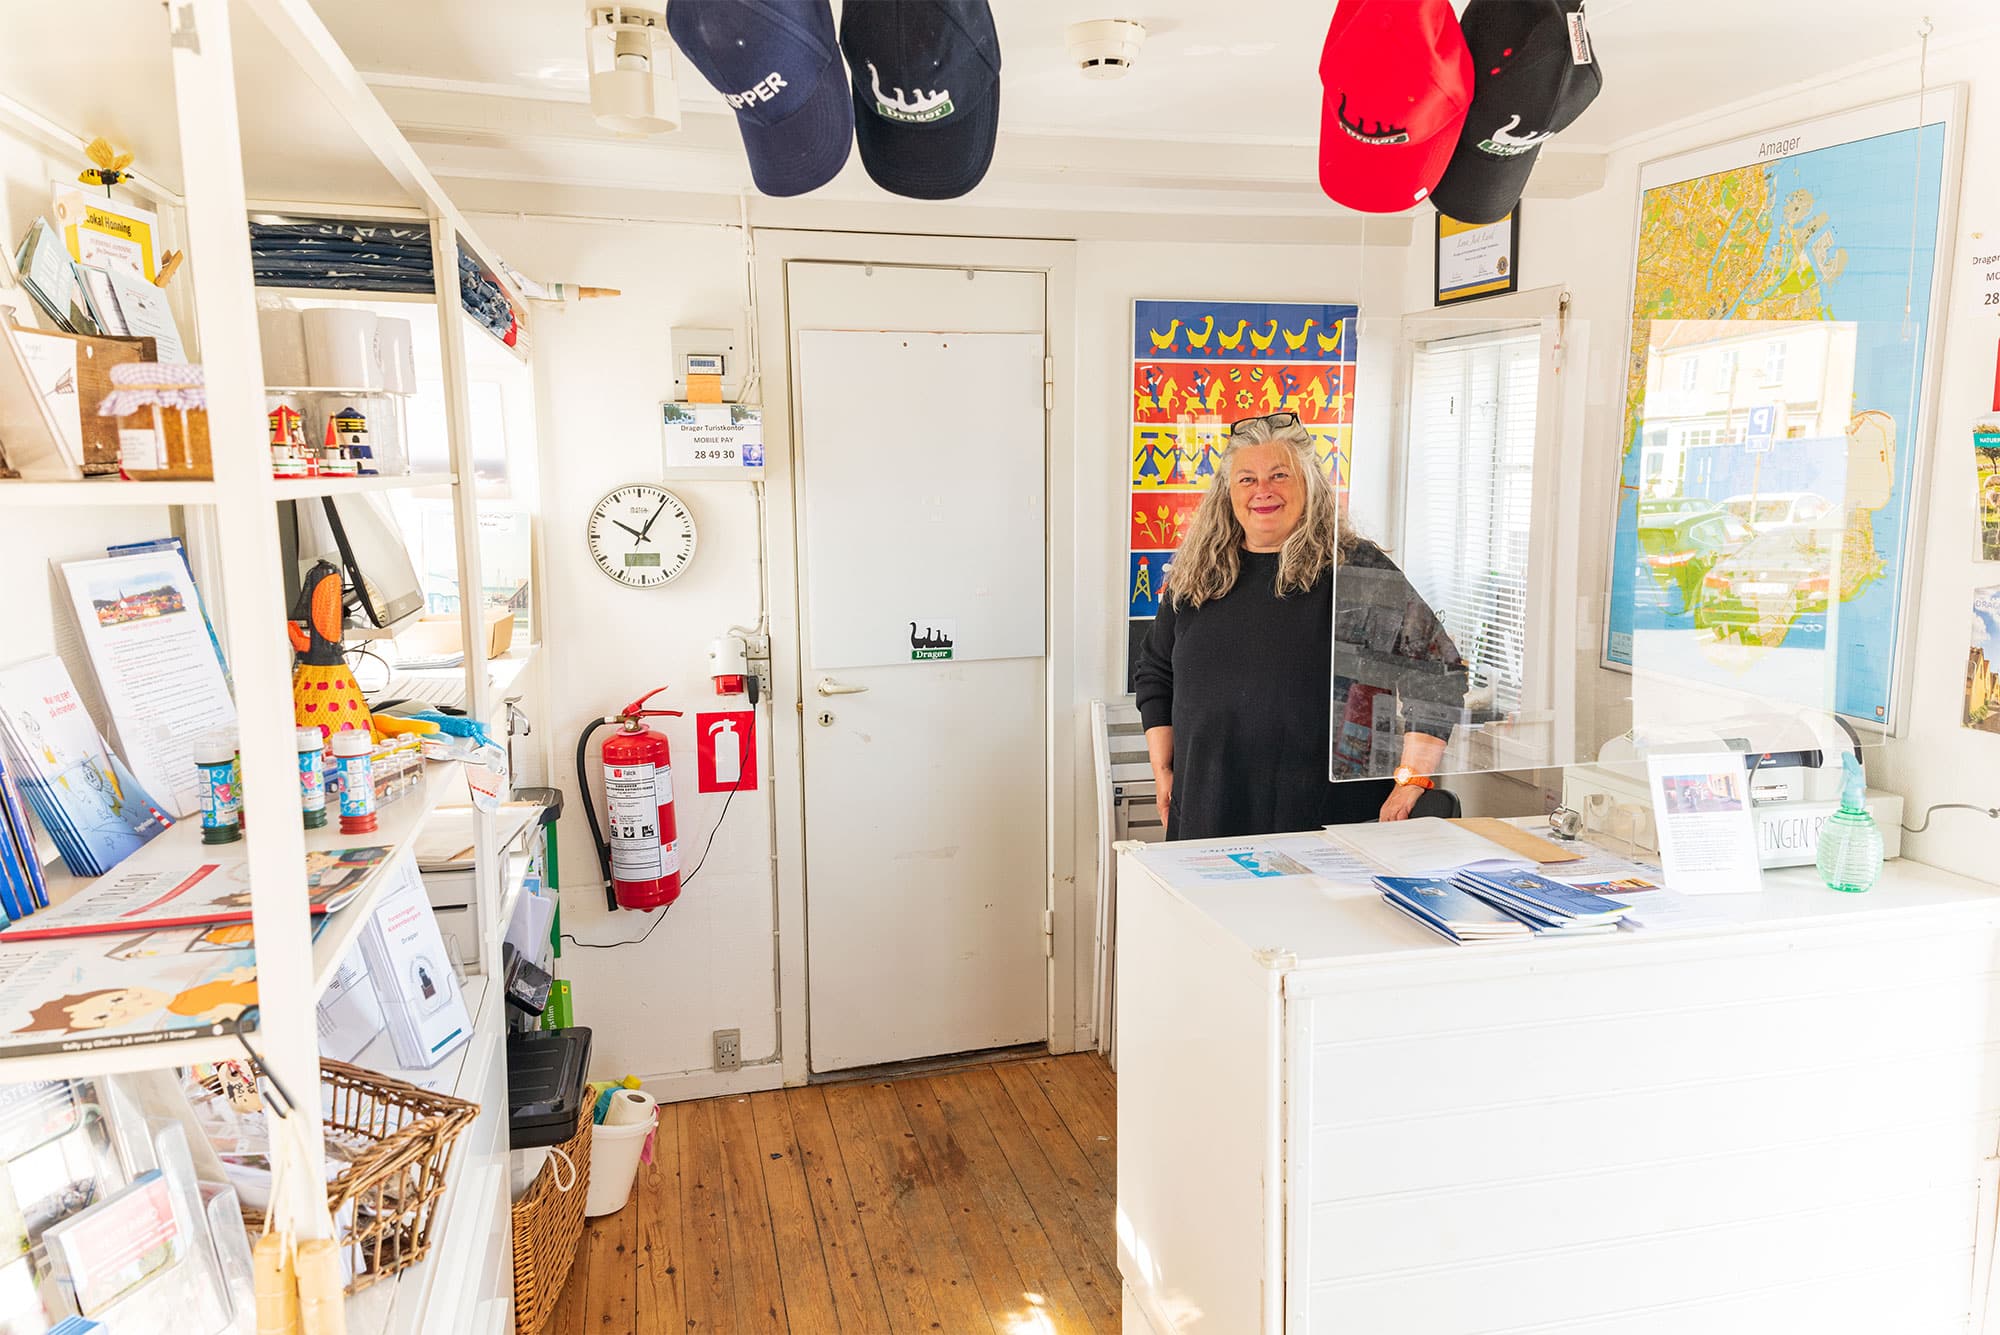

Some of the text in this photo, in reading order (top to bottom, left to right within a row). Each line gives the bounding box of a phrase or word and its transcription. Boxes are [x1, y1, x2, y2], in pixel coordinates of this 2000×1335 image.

[1759, 136, 1801, 157] Amager
[104, 216, 132, 237] Honning
[1984, 292, 2000, 305] 28
[680, 425, 703, 433] Dragør
[694, 450, 735, 459] 28 49 30
[1762, 818, 1809, 851] INGEN
